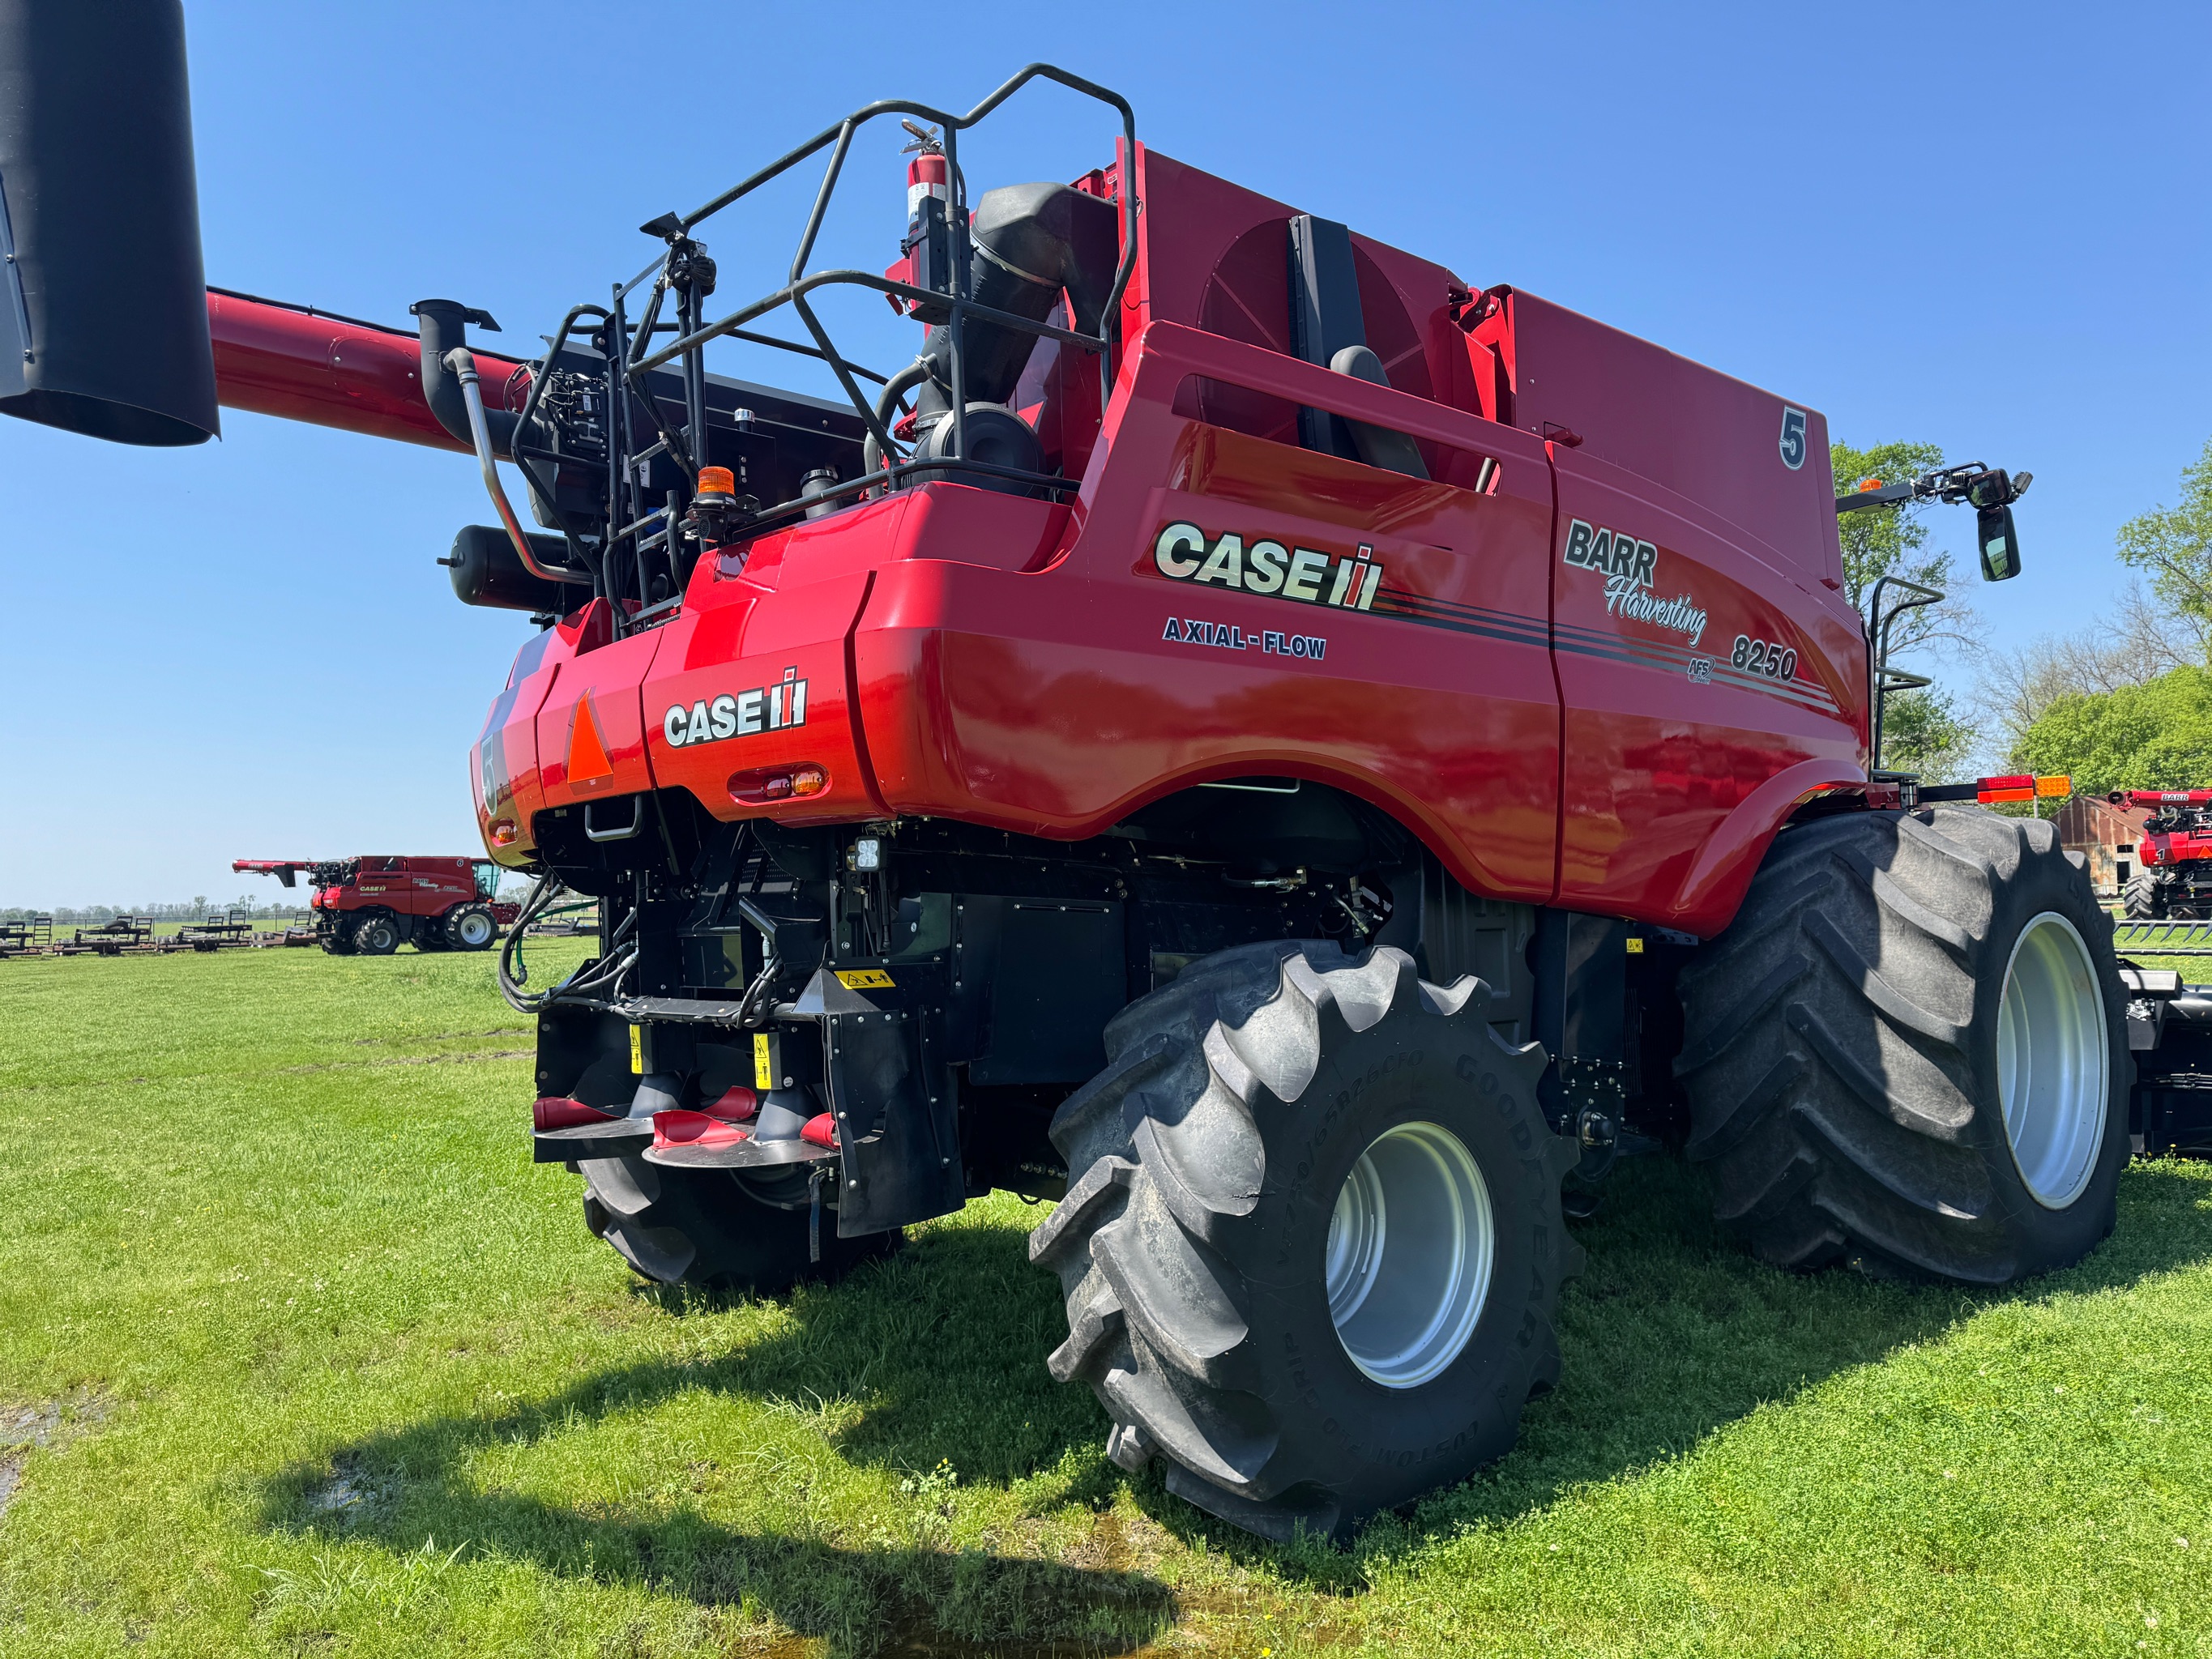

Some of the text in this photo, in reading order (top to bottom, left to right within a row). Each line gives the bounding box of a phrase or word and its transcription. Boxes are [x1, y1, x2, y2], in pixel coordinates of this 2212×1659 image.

[1779, 405, 1806, 471] 5
[1154, 521, 1330, 601] CASE
[1563, 518, 1658, 588] BARR
[1162, 616, 1327, 660] AXIAL-FLOW
[1603, 574, 1707, 647] Harvesting
[1687, 658, 1710, 676] AFS
[1731, 634, 1798, 683] 8250
[664, 687, 765, 748] CASE
[480, 733, 497, 817] 5
[2161, 793, 2189, 801] BARR
[456, 859, 464, 868] 6
[2155, 848, 2165, 859] 1
[1455, 1053, 1550, 1350] GOODYEAR
[1284, 1331, 1480, 1469] CUSTOM FLO GRIP
